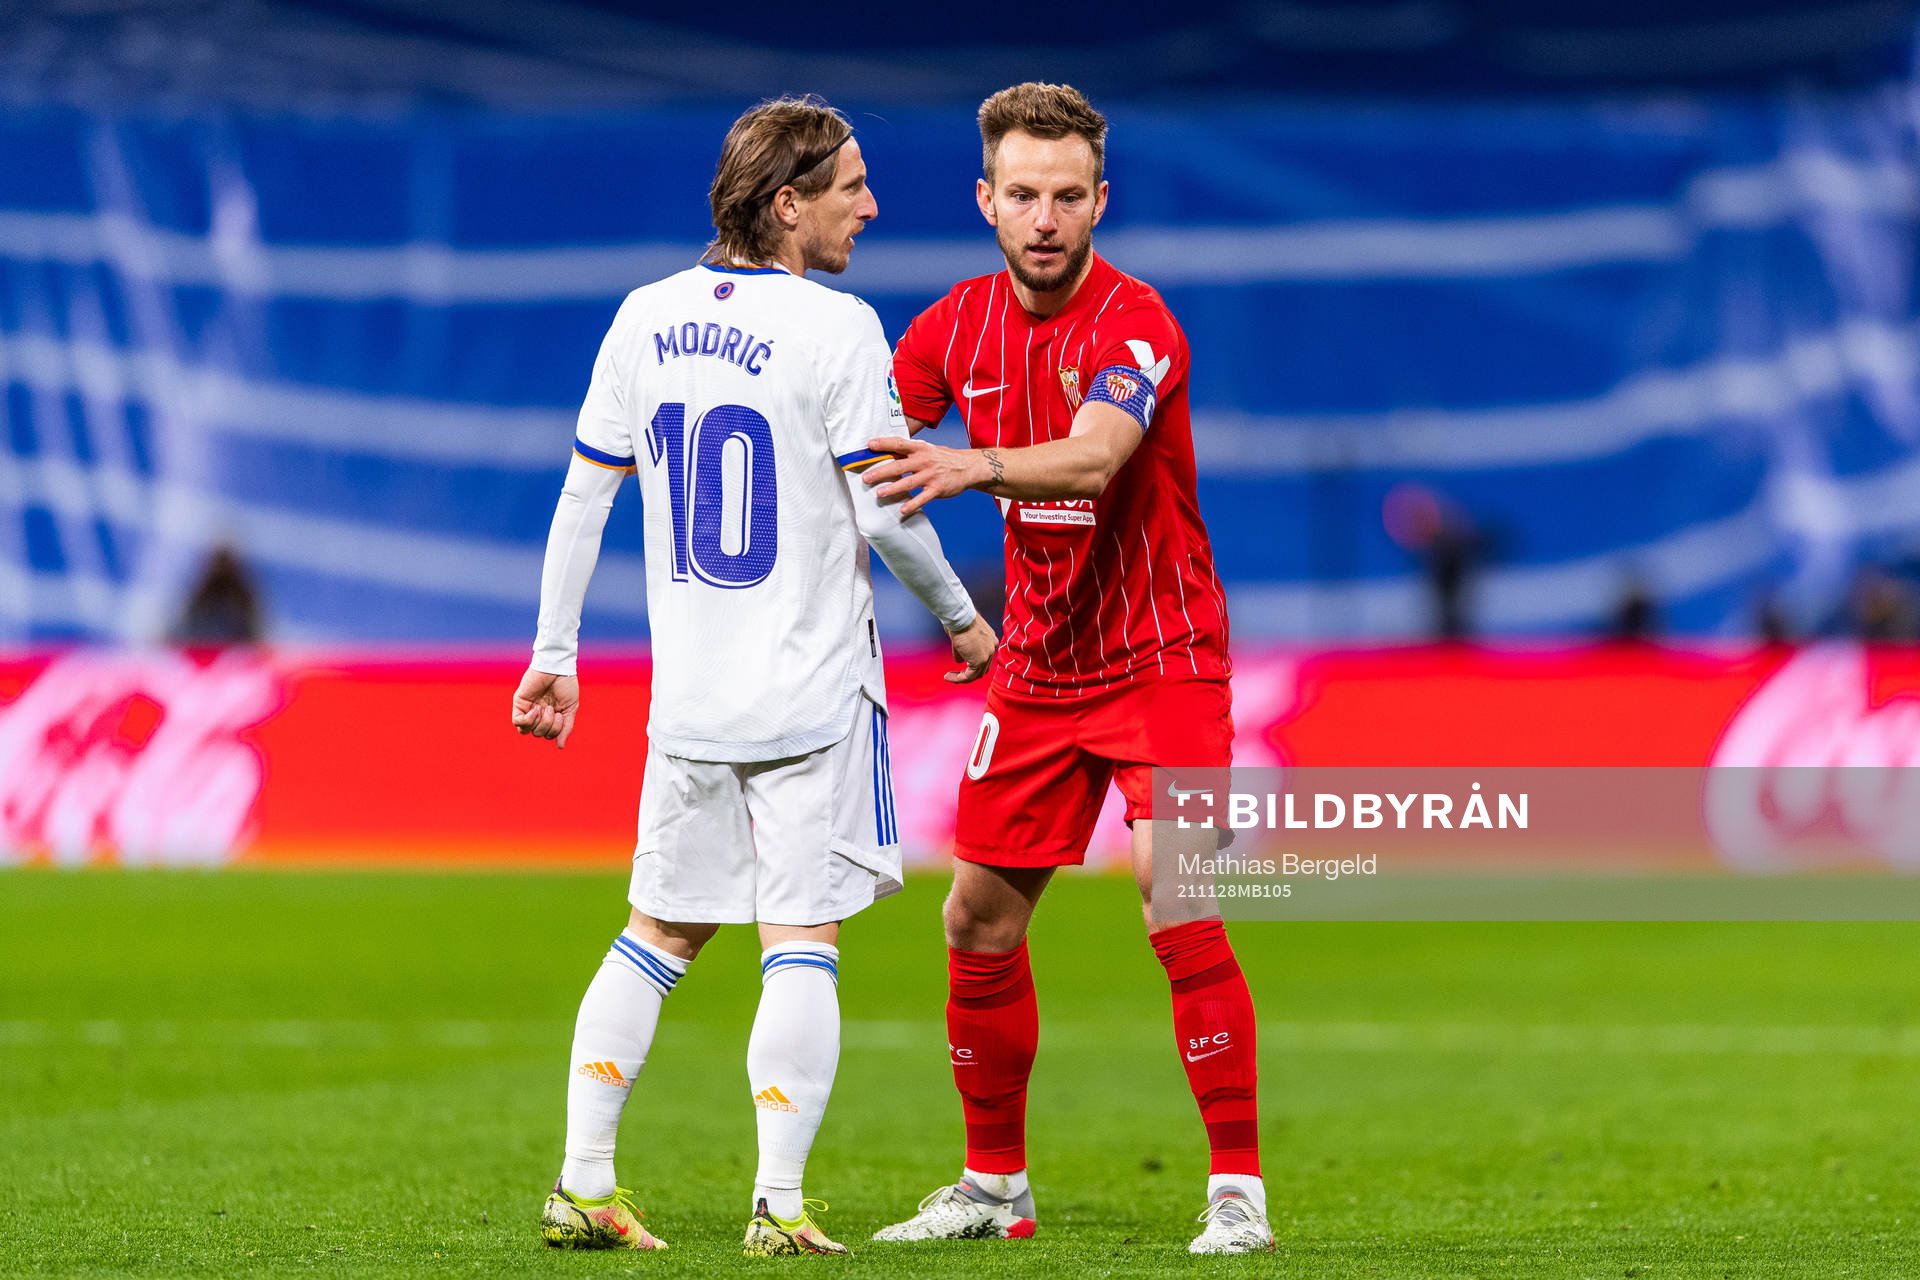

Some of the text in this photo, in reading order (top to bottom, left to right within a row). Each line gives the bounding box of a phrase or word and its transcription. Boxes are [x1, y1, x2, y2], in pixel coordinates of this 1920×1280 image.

[653, 321, 775, 377] MODRIĆ
[644, 402, 778, 590] 10
[1023, 511, 1094, 523] Your Investing Super App
[577, 1066, 630, 1089] adidas
